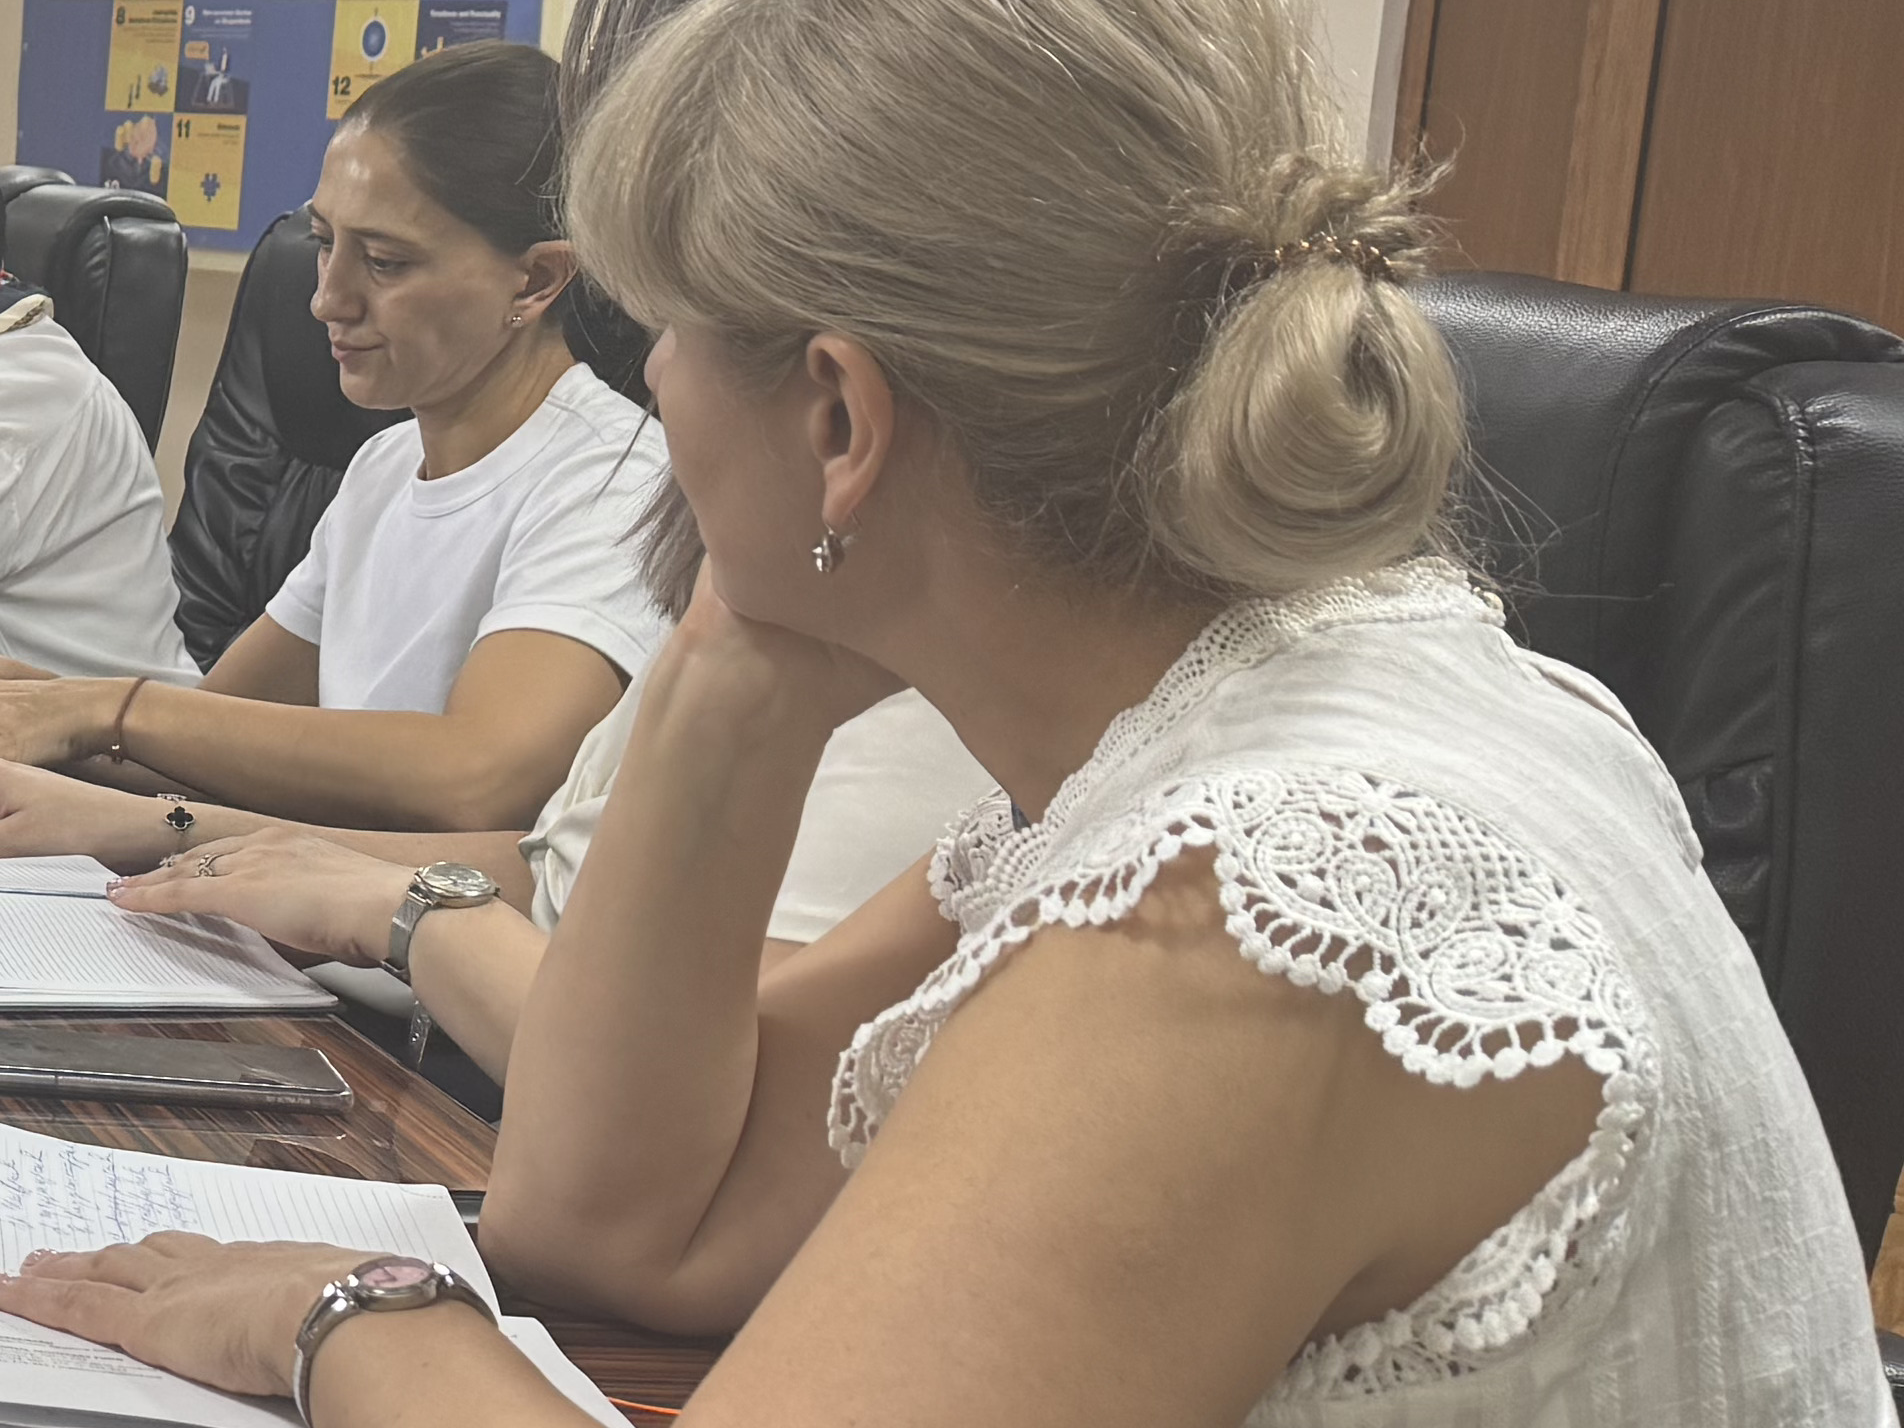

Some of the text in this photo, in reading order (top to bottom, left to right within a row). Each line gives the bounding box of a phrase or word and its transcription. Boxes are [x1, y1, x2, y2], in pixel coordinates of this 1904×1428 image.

[116, 6, 126, 25] 8
[185, 5, 196, 26] 9
[332, 76, 351, 96] 12
[176, 119, 191, 138] 11
